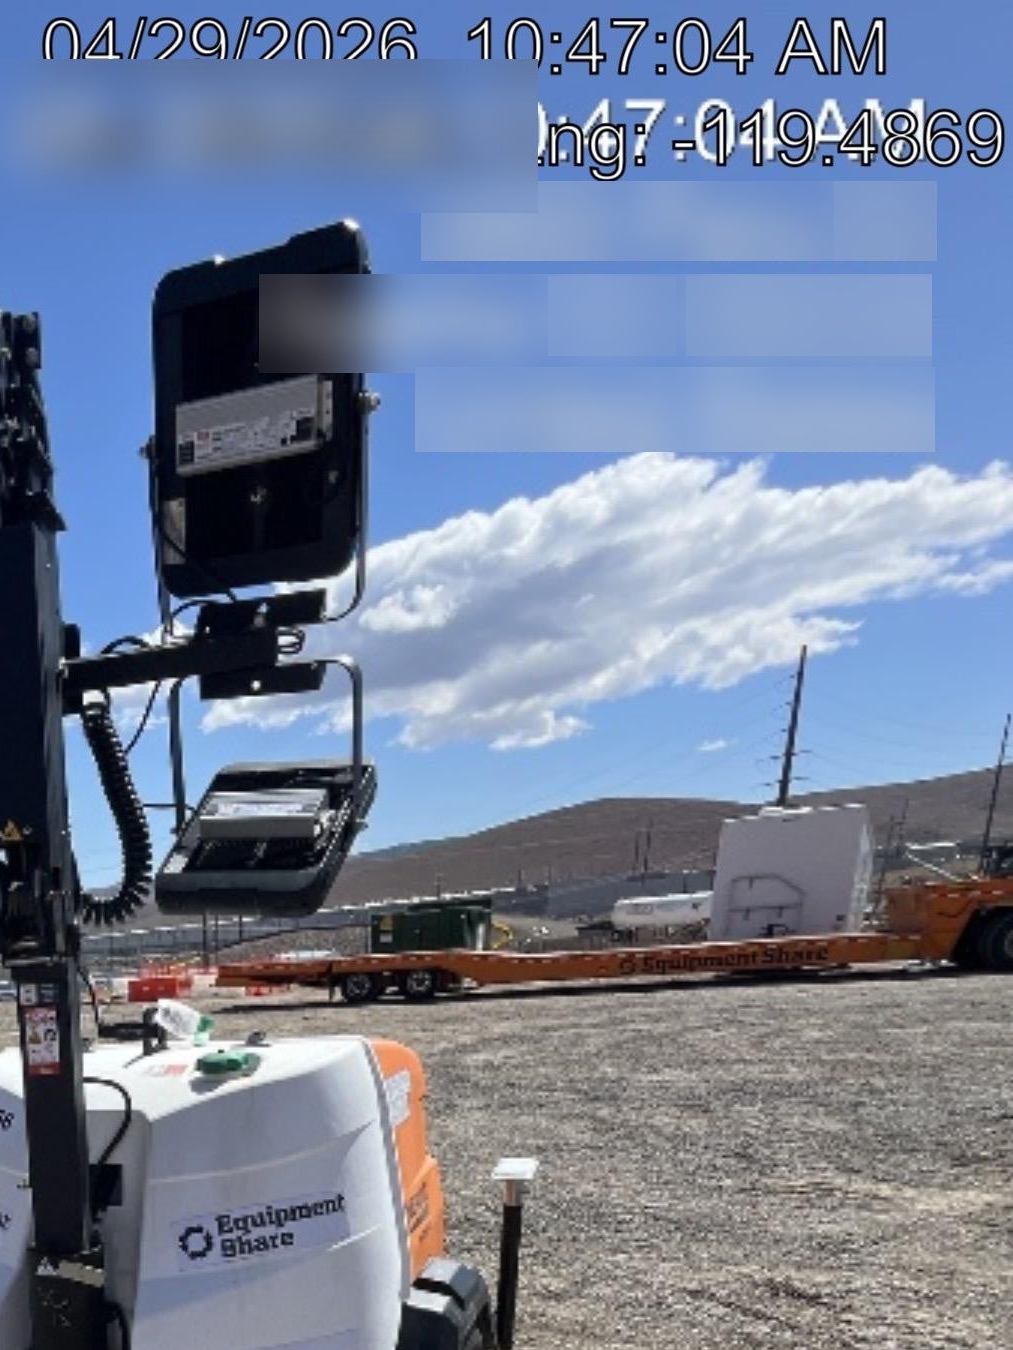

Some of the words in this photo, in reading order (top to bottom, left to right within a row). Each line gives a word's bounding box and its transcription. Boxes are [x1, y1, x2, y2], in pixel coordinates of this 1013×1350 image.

[642, 950, 757, 977] Equipment
[762, 947, 829, 965] Share
[215, 1193, 345, 1236] Equipment
[220, 1231, 294, 1258] Share
